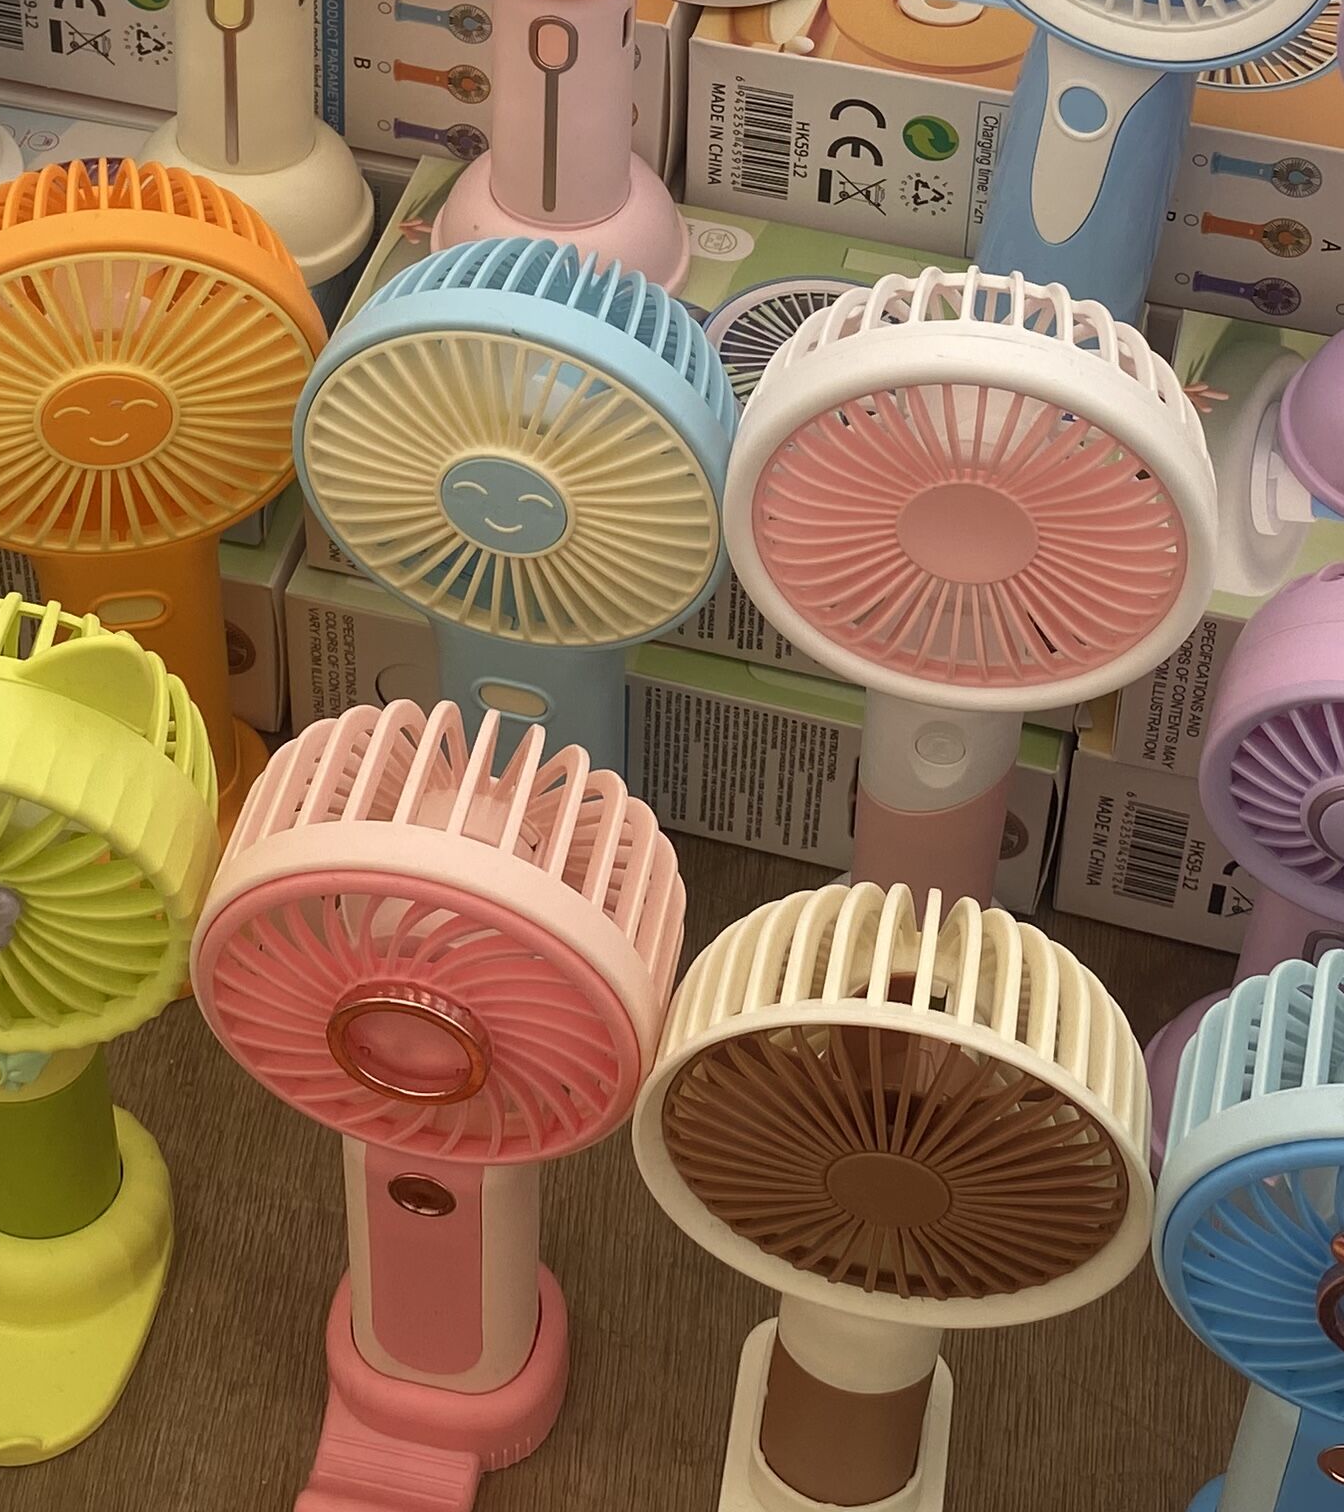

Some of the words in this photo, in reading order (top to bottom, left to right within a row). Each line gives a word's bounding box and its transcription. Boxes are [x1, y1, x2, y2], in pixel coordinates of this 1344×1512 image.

[710, 82, 726, 123] MADE
[709, 125, 723, 140] IN
[793, 120, 809, 178] HK59-12
[977, 114, 999, 166] Charging
[707, 142, 722, 186] CHINA
[308, 606, 319, 635] VARY
[325, 610, 337, 653] COLORS
[310, 635, 321, 665] FROM
[327, 654, 338, 669] OF
[342, 614, 356, 696] SPECIFICATIONS
[1189, 620, 1217, 713] SPECIFICATIONS
[1174, 666, 1189, 683] OF
[1164, 683, 1186, 744] CONTENTS
[1185, 712, 1202, 738] AND
[1160, 744, 1176, 769] MAY
[1097, 795, 1113, 832] MADE
[1093, 832, 1108, 847] IN
[1085, 848, 1106, 887] CHINA
[1181, 838, 1205, 891] HK59-12
